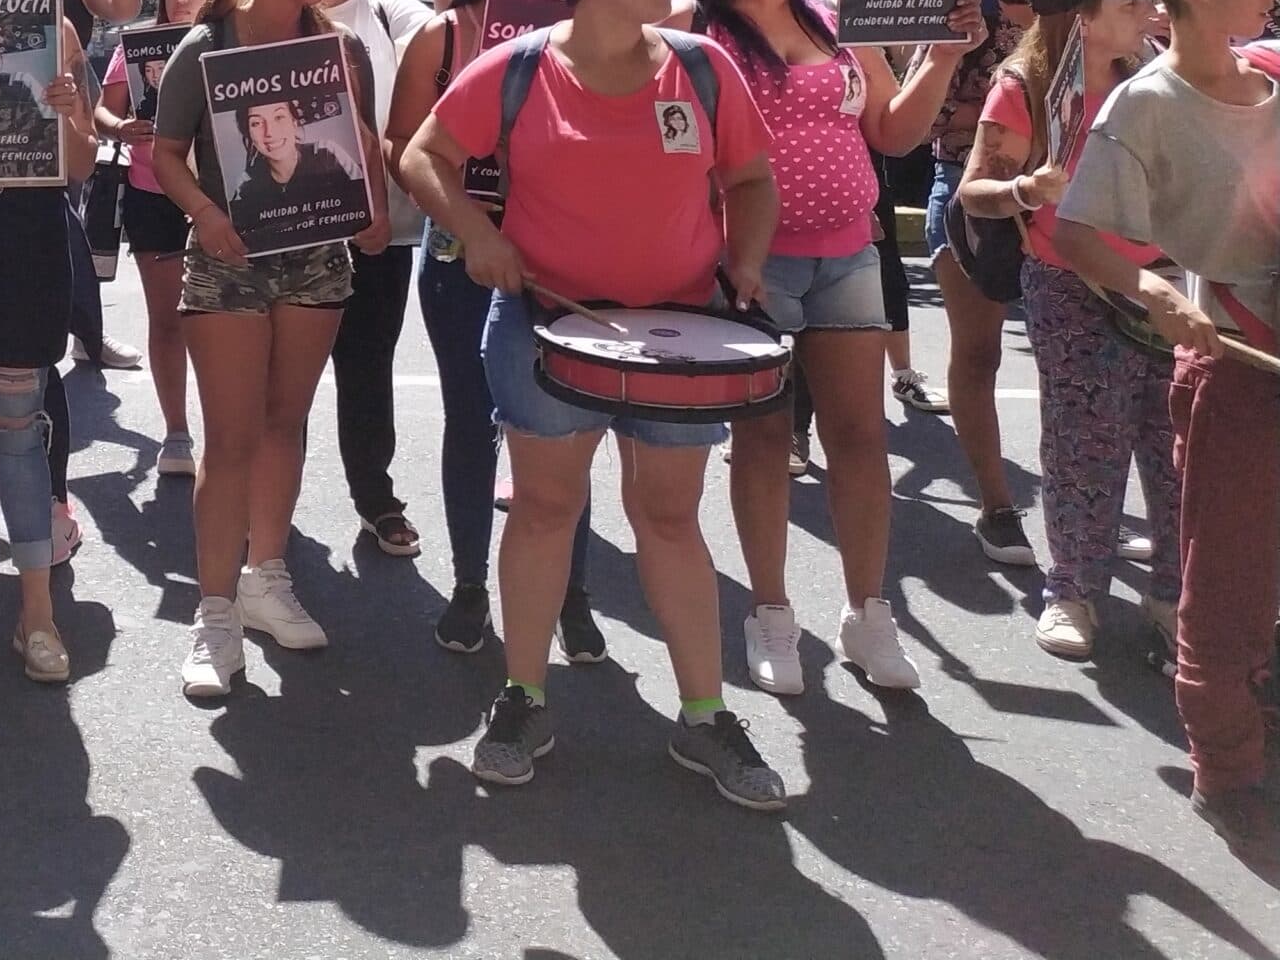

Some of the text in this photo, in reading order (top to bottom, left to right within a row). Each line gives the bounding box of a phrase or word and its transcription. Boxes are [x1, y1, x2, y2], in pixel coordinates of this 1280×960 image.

[866, 0, 943, 9] NULIDAD AL FALLO
[844, 15, 948, 26] Y CONDENA POR FEMICI
[488, 22, 535, 40] SOM
[127, 45, 162, 58] SOMOS
[214, 59, 340, 101] SOMOS LUCÍA
[0, 135, 29, 144] FALLO
[1, 151, 53, 161] FEMICIDIO
[471, 166, 477, 175] Y
[259, 198, 341, 220] NULIDAD AL FALLO
[319, 210, 366, 225] FEMICIDIO
